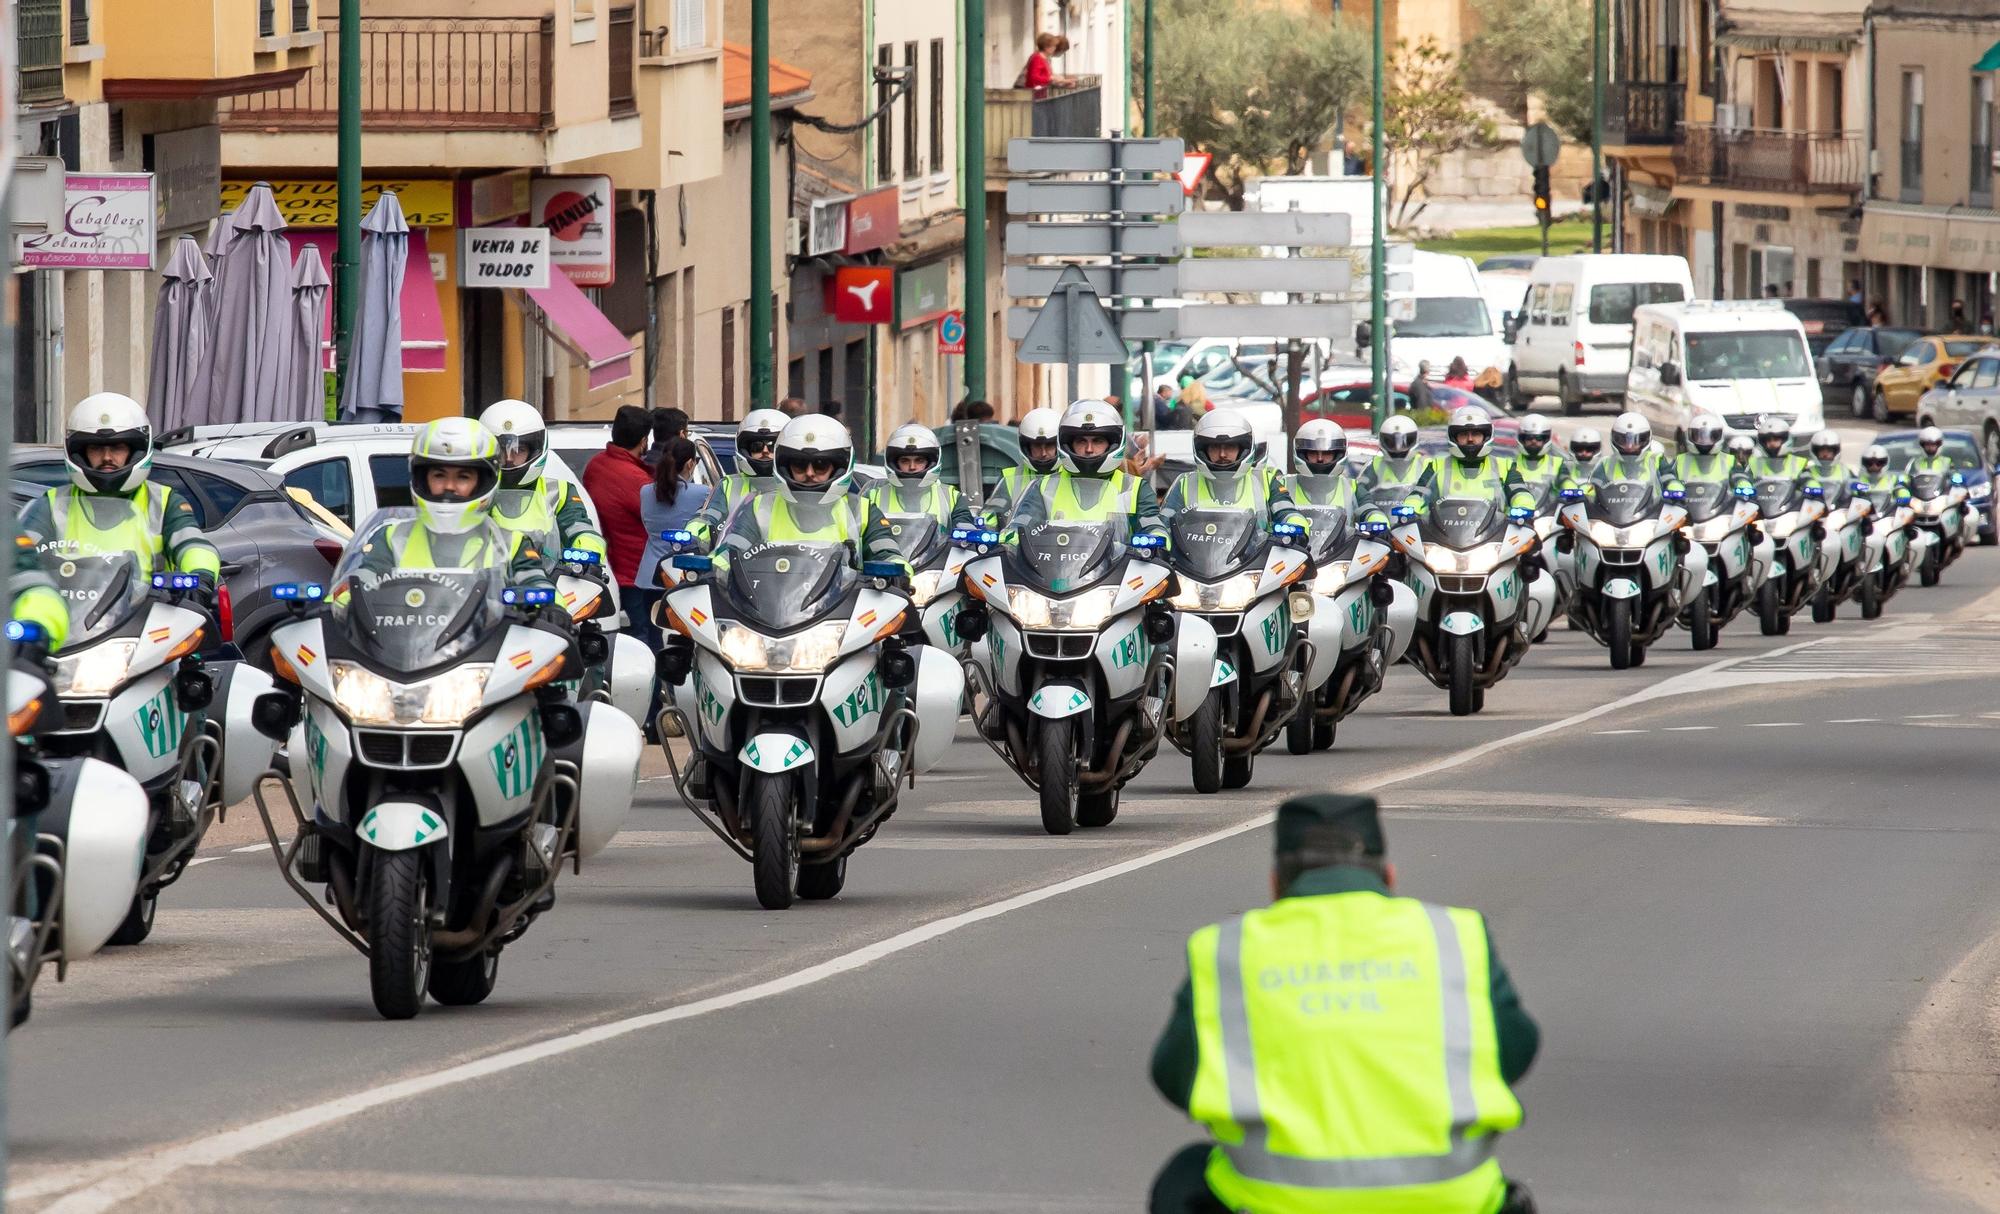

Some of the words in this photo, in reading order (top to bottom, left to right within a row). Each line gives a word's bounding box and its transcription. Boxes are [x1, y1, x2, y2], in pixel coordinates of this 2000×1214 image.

[65, 195, 144, 237] Caballero
[472, 239, 514, 254] VENTA
[521, 239, 540, 254] DE
[478, 263, 534, 277] TOLDOS
[940, 314, 965, 345] 6
[1443, 519, 1481, 527] TRAFICO
[1186, 533, 1232, 545] TRAFICO
[798, 543, 825, 563] CVIL
[1038, 552, 1089, 561] TRFICO
[375, 614, 448, 627] TRAFICO
[1259, 957, 1420, 990] GUARDIA
[1300, 991, 1383, 1014] CIVIL
